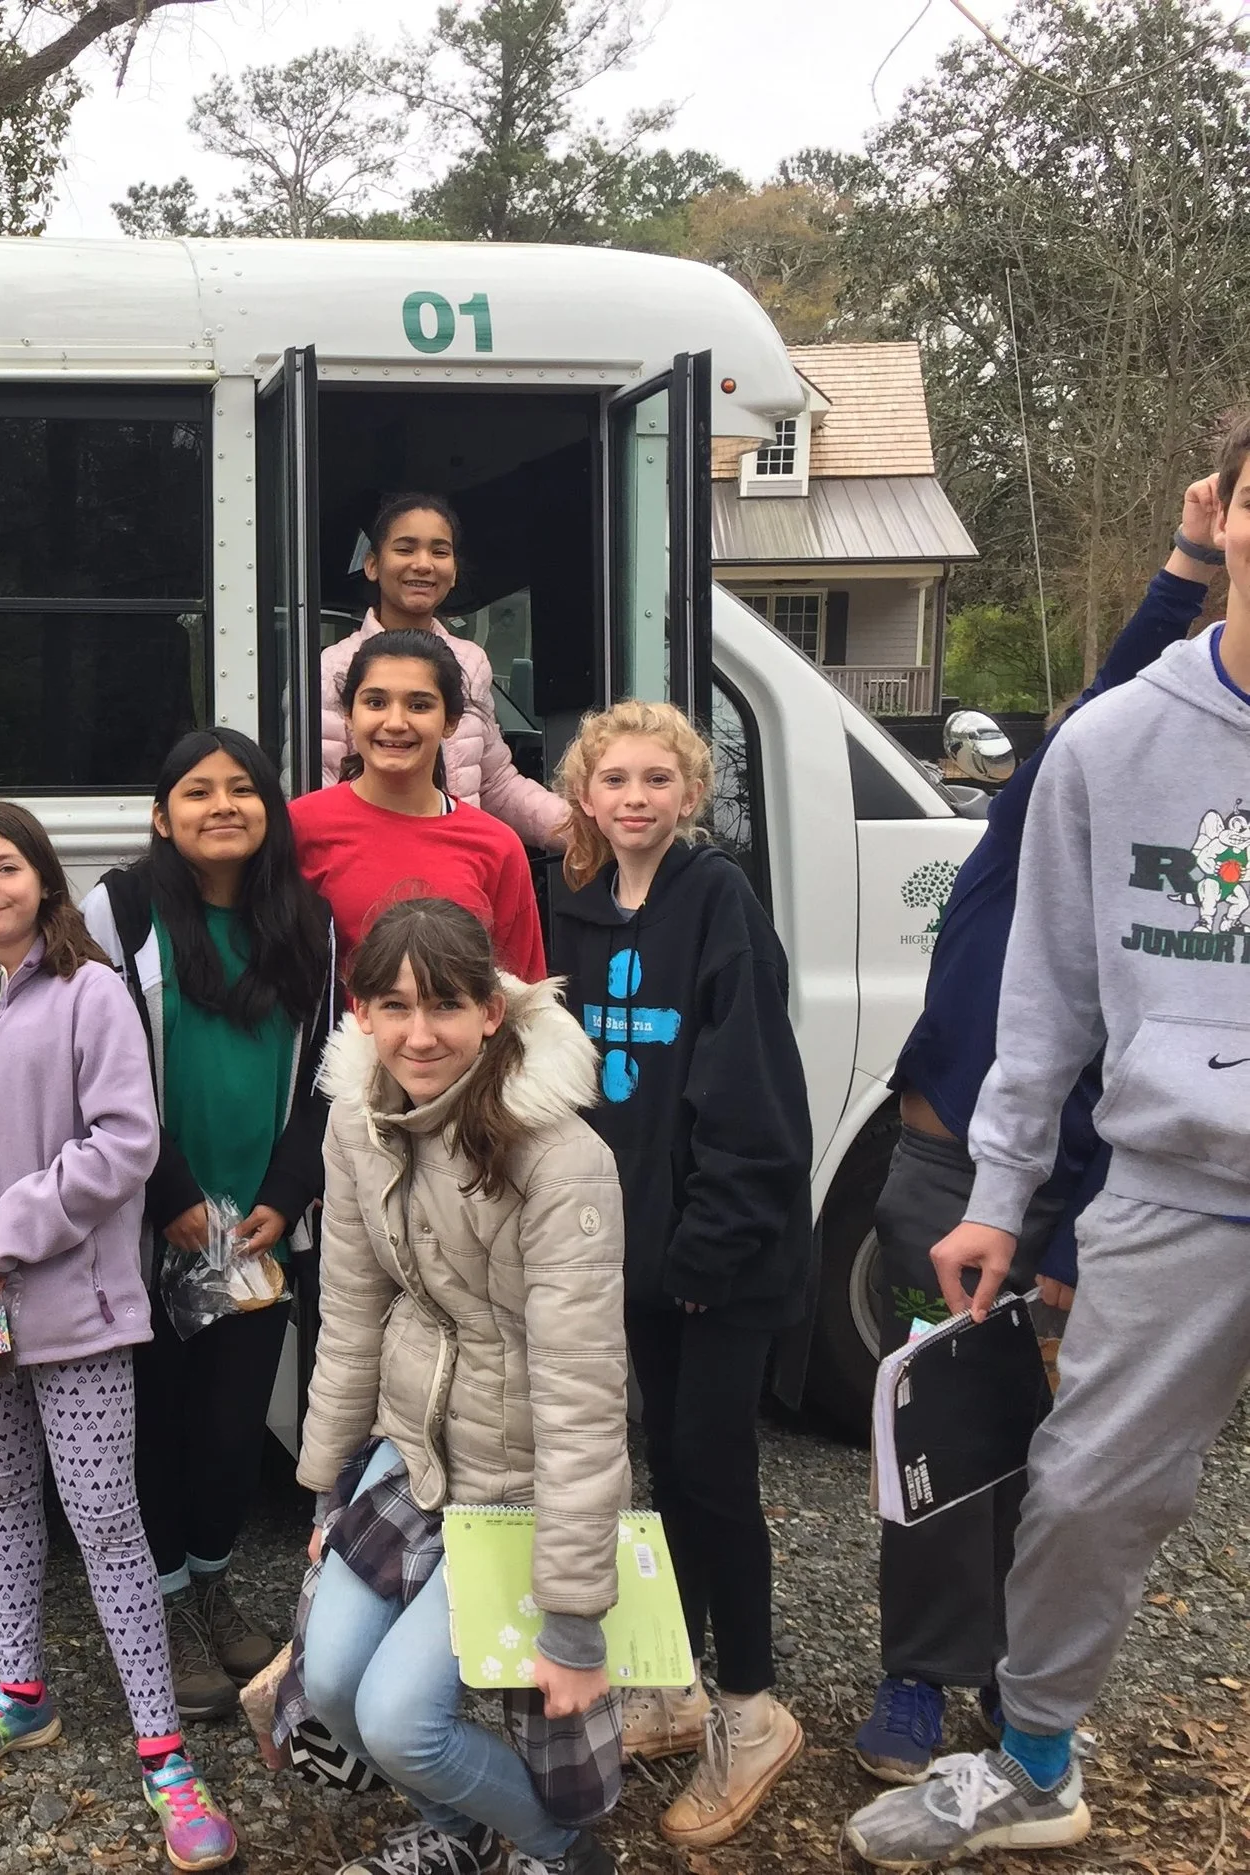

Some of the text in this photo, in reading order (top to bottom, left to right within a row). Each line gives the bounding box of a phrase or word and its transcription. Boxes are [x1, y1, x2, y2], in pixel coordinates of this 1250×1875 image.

[402, 291, 493, 354] 01
[900, 935, 928, 944] HIGH
[1121, 922, 1235, 963] JUNIOR
[919, 1462, 934, 1504] SUBJECT
